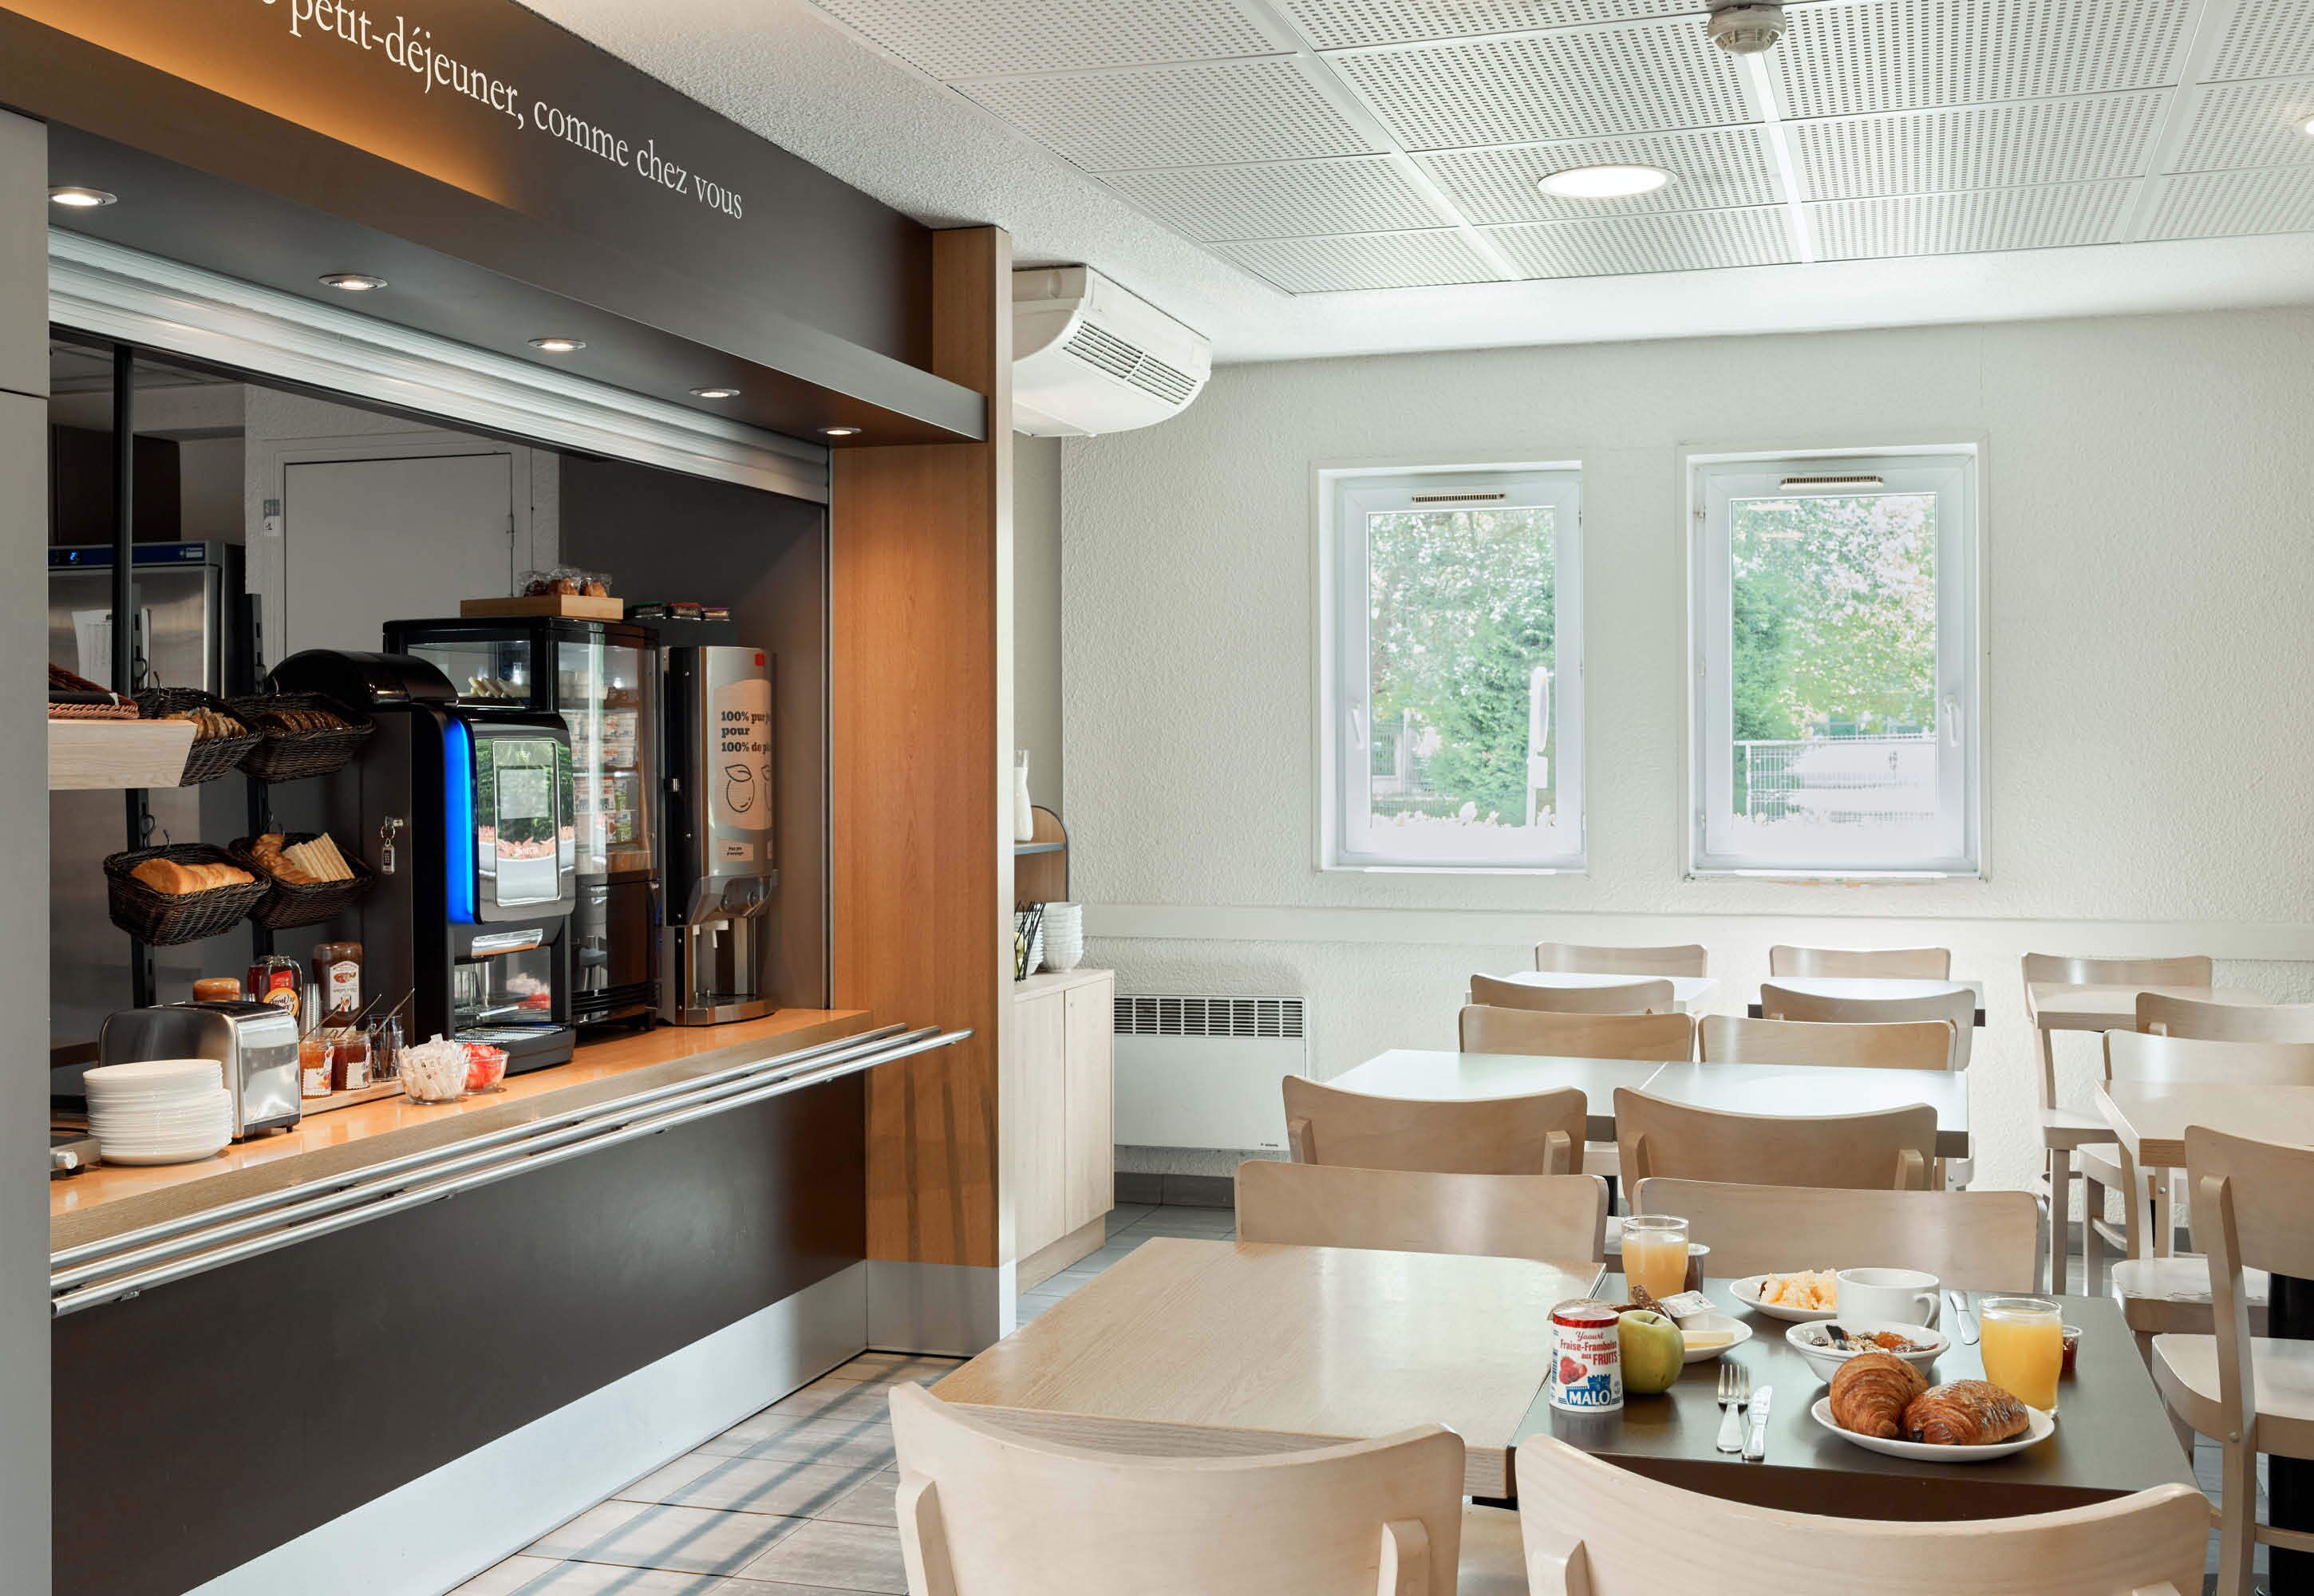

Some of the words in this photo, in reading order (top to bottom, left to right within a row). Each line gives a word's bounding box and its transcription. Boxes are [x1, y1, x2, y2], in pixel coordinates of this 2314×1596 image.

[290, 0, 524, 129] petit-déjeuner,
[534, 101, 629, 167] comme
[637, 139, 687, 195] chez
[693, 174, 743, 219] vous
[721, 710, 749, 722] 100%
[721, 727, 750, 739] pour
[721, 741, 750, 753] 100%
[1593, 1351, 1617, 1365] FRUITS
[1569, 1390, 1610, 1405] MALO
